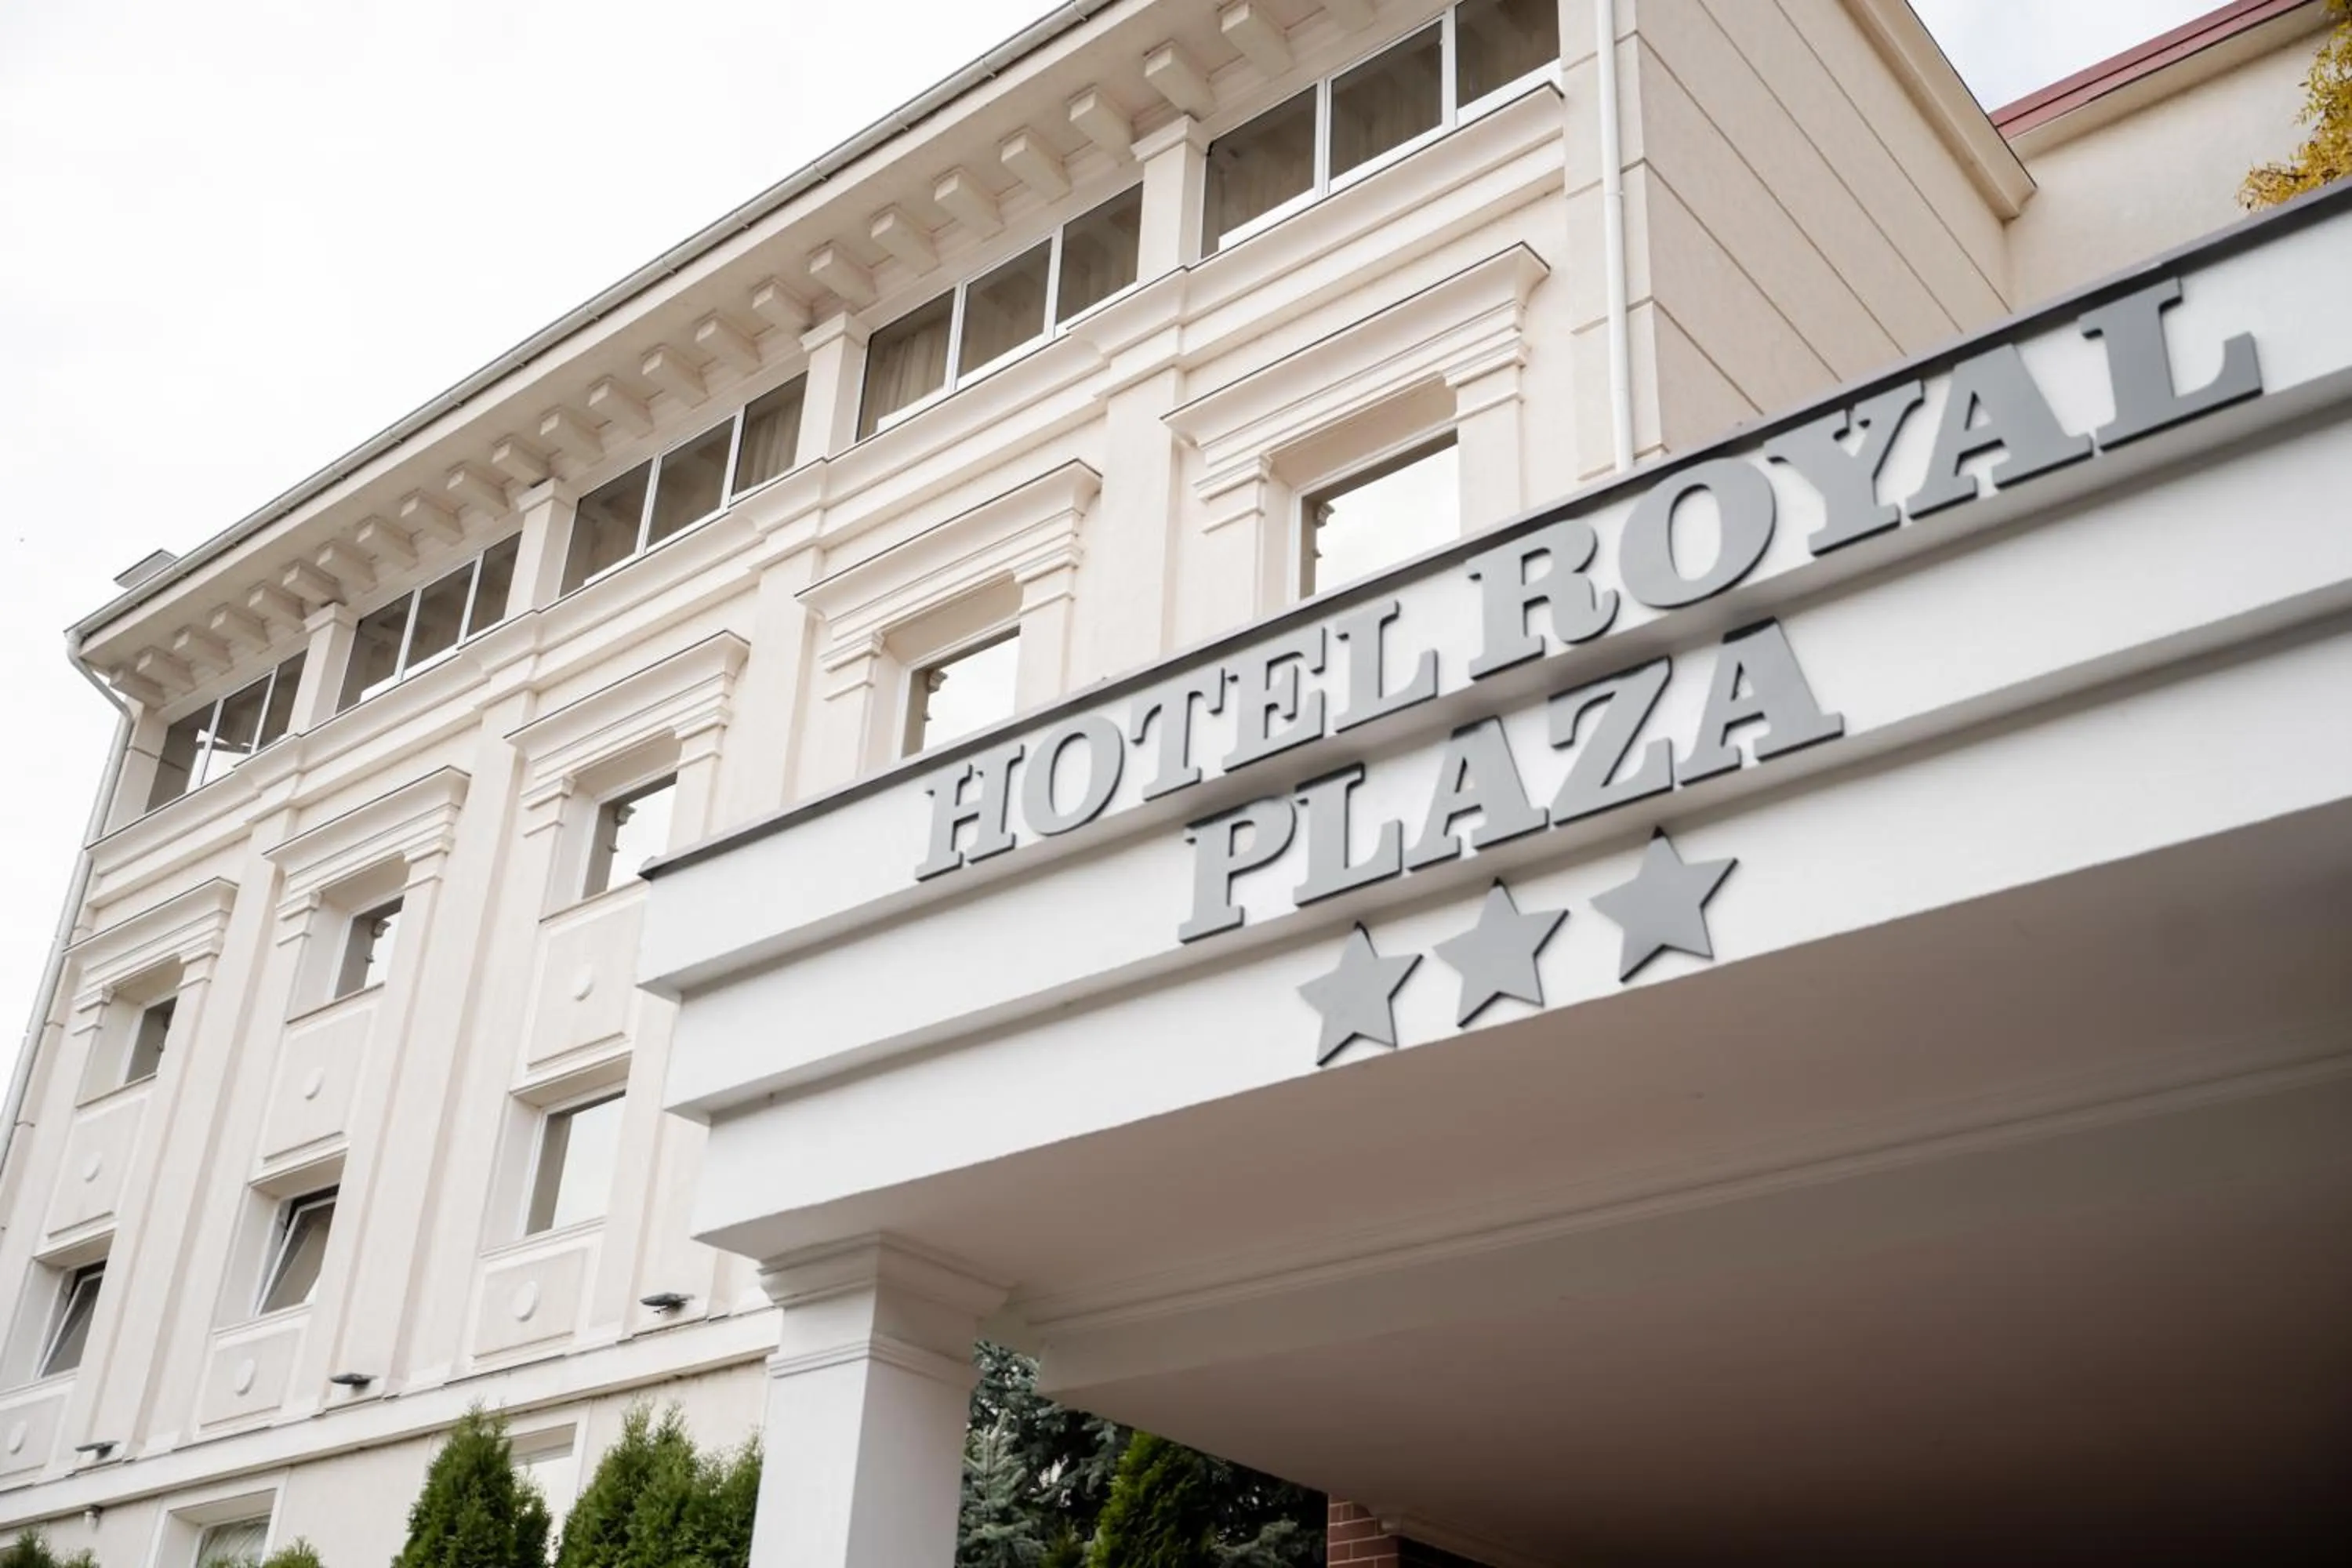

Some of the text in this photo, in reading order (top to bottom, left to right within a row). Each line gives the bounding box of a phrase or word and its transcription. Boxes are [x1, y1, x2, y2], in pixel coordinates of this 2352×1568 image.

[916, 277, 2263, 881] HOTEL ROYAL
[1178, 617, 1843, 943] PLAZA
